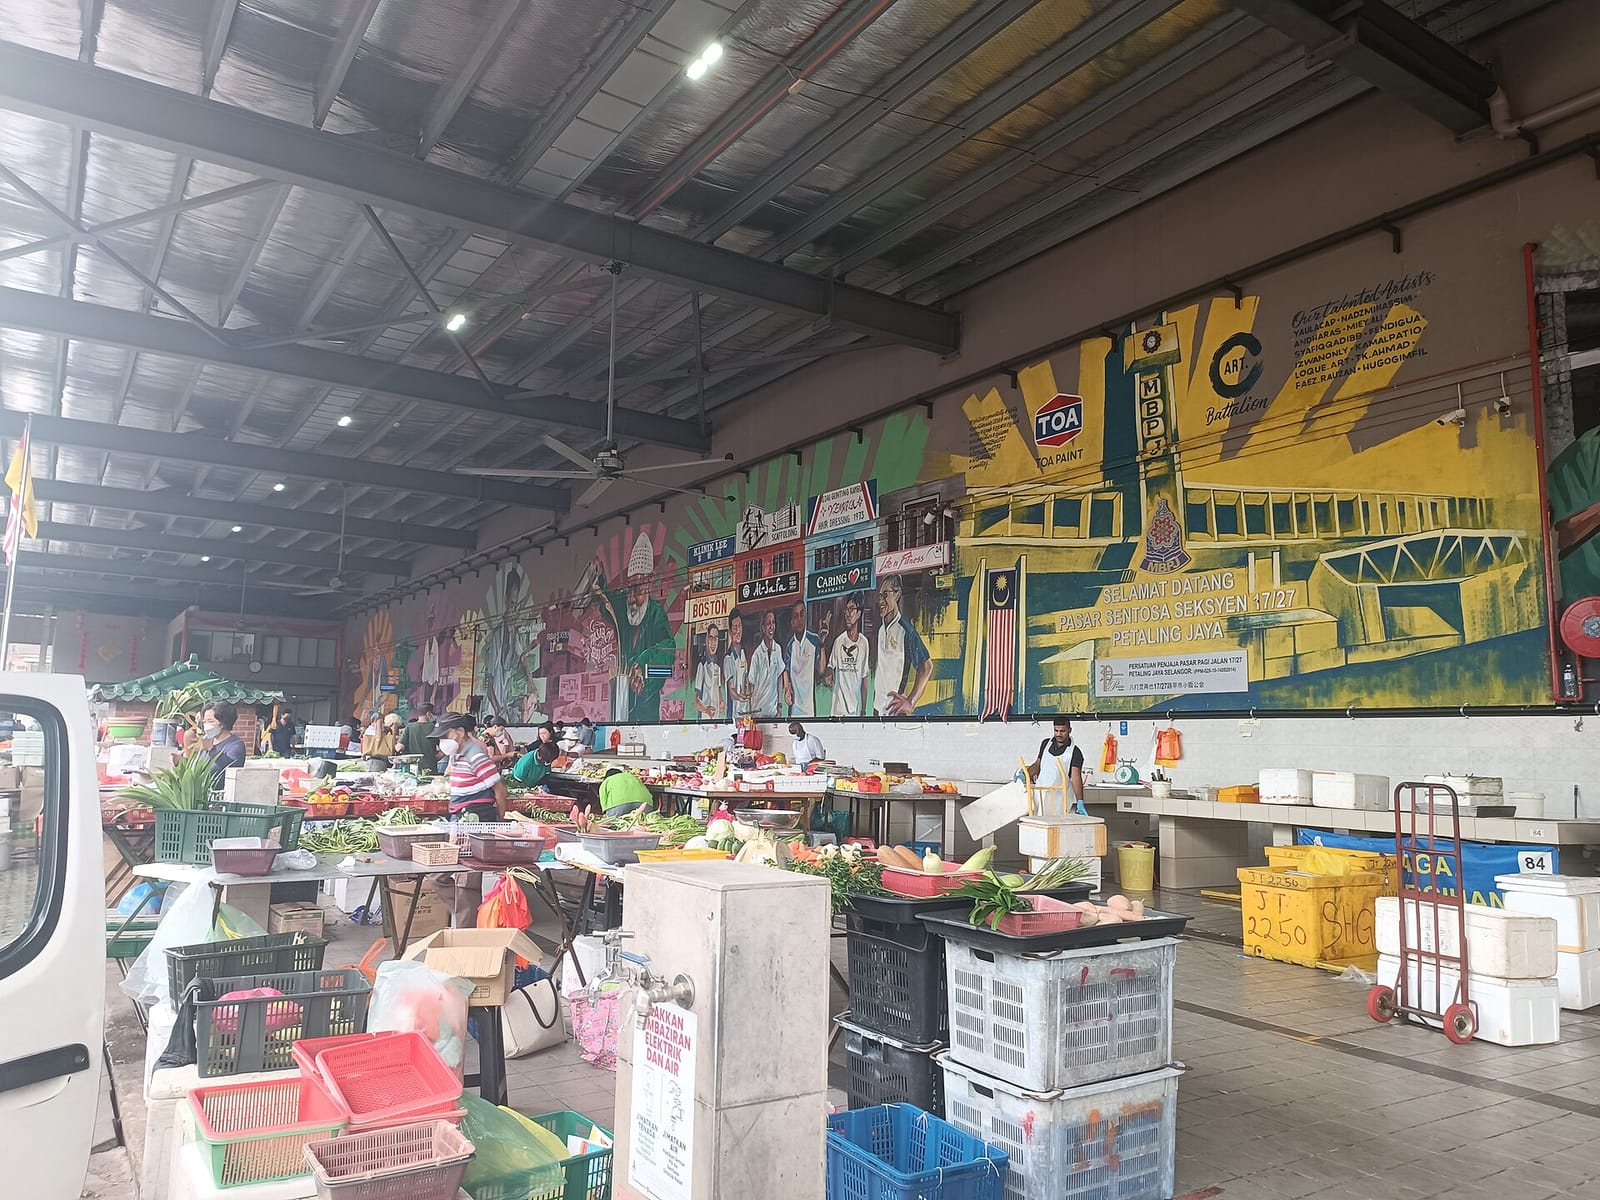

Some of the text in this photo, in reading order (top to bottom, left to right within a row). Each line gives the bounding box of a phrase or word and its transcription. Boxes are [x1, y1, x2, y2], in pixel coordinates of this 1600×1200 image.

[1294, 319, 1336, 337] YAULACAP
[1369, 314, 1421, 335] FENDIGUA
[1294, 328, 1341, 347] ANDHARAS
[1295, 326, 1421, 368] IZWANONLY KAMALPATIO
[1206, 396, 1269, 425] Battalion
[1038, 407, 1080, 435] TOA
[1036, 449, 1084, 469] TOA PAINT
[830, 514, 851, 528] DRESSING
[853, 511, 865, 521] 1973
[772, 527, 798, 541] SCAFFOLDING
[715, 539, 728, 550] LEE
[1147, 557, 1181, 573] MBPJ
[816, 573, 847, 588] CARING
[1103, 572, 1235, 604] SELAMAT DATANG
[692, 599, 728, 618] BOSTON
[1059, 589, 1296, 631] PASAR SENTOSA SEKSYEN 17/27
[1112, 621, 1225, 647] PETALING JAYA
[1129, 662, 1156, 670] PERSATUAN
[1229, 656, 1242, 664] 17/27
[1525, 857, 1546, 870] 84
[1268, 874, 1299, 888] 2250
[1248, 916, 1307, 946] 2250
[651, 1005, 684, 1031] AKKAN
[646, 1018, 691, 1051] MBAZIRAN
[645, 1031, 681, 1062] ELEKTRIK
[647, 1047, 679, 1077] DAN AIR
